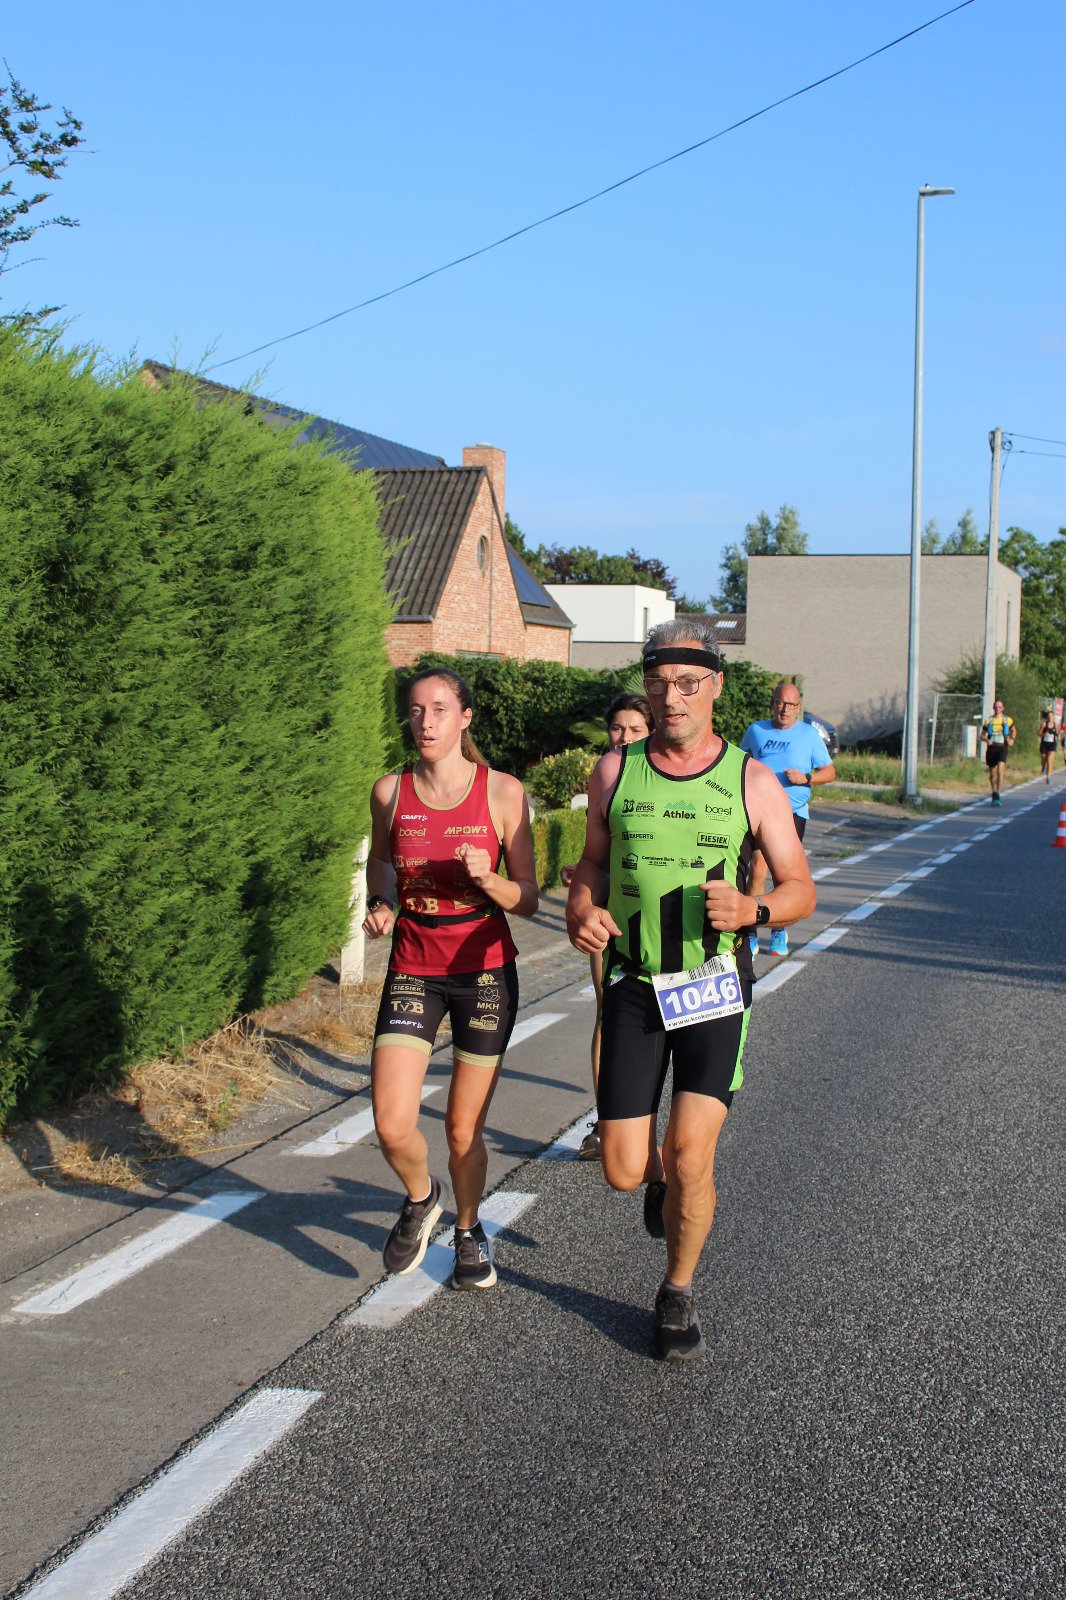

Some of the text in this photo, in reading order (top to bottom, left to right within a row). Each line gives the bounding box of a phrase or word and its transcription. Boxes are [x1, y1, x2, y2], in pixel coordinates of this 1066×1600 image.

[763, 739, 791, 751] RUN
[705, 779, 733, 799] BIORACER
[635, 804, 655, 813] press
[444, 825, 488, 835] MPOWR
[700, 834, 728, 845] FIESIEK
[665, 977, 738, 1014] 1046
[476, 1002, 499, 1010] MKH
[390, 1019, 417, 1027] CRAFT
